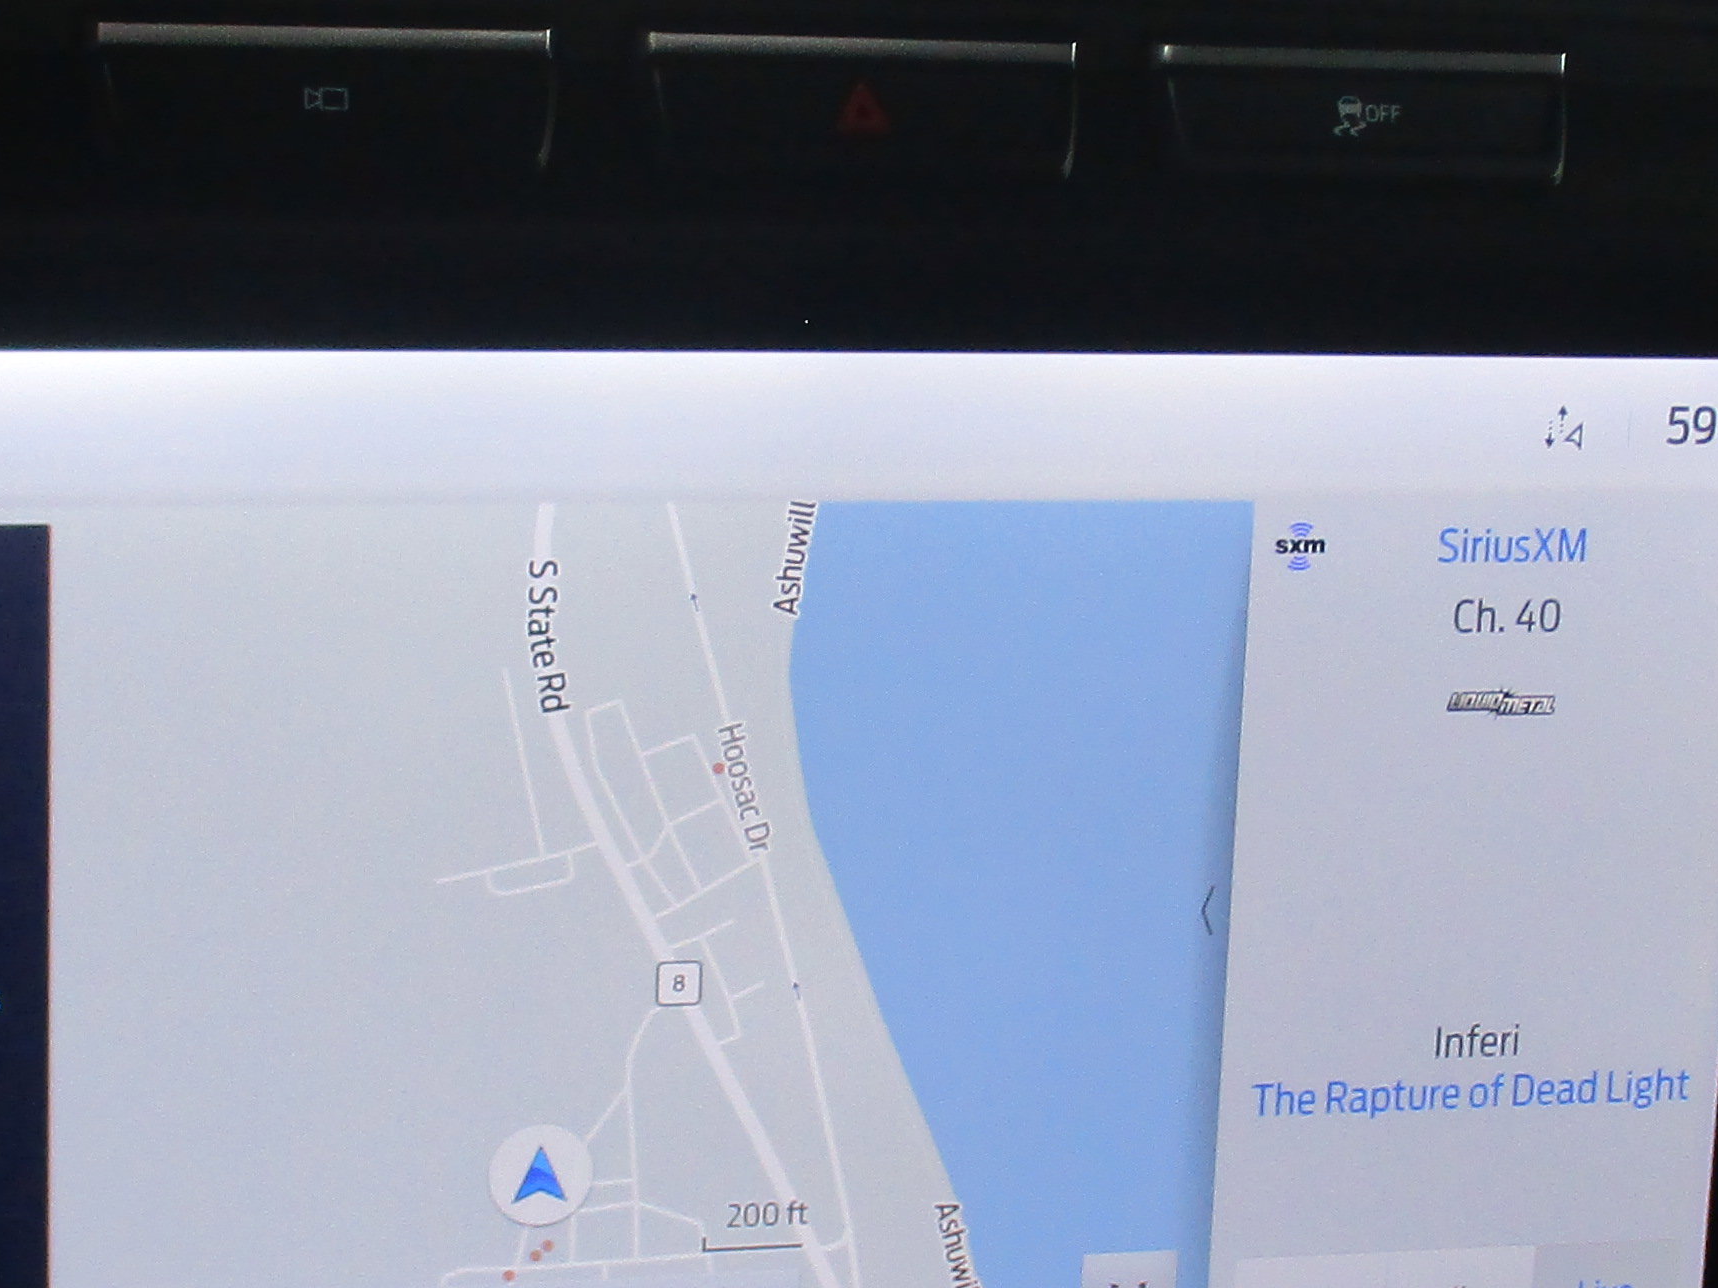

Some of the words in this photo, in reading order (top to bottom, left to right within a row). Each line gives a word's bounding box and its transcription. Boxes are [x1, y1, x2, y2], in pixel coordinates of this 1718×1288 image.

[1365, 103, 1402, 123] OFF
[1274, 536, 1326, 556] sxm
[1437, 526, 1588, 564] SiriusXM
[527, 559, 558, 579] S
[527, 587, 559, 669] State
[1453, 598, 1505, 634] Ch.
[1515, 596, 1562, 634] 40
[534, 673, 571, 714] Rd
[719, 722, 762, 820] Hoosac
[741, 820, 772, 854] Dr
[673, 975, 685, 993] 8
[1434, 1023, 1519, 1062] Inferi
[1252, 1080, 1316, 1117] The
[1325, 1076, 1459, 1120] Rapture
[1469, 1073, 1504, 1110] of
[1511, 1072, 1596, 1108] Dead
[1605, 1068, 1690, 1110] Light
[726, 1202, 779, 1229] 200
[784, 1198, 809, 1227] ft
